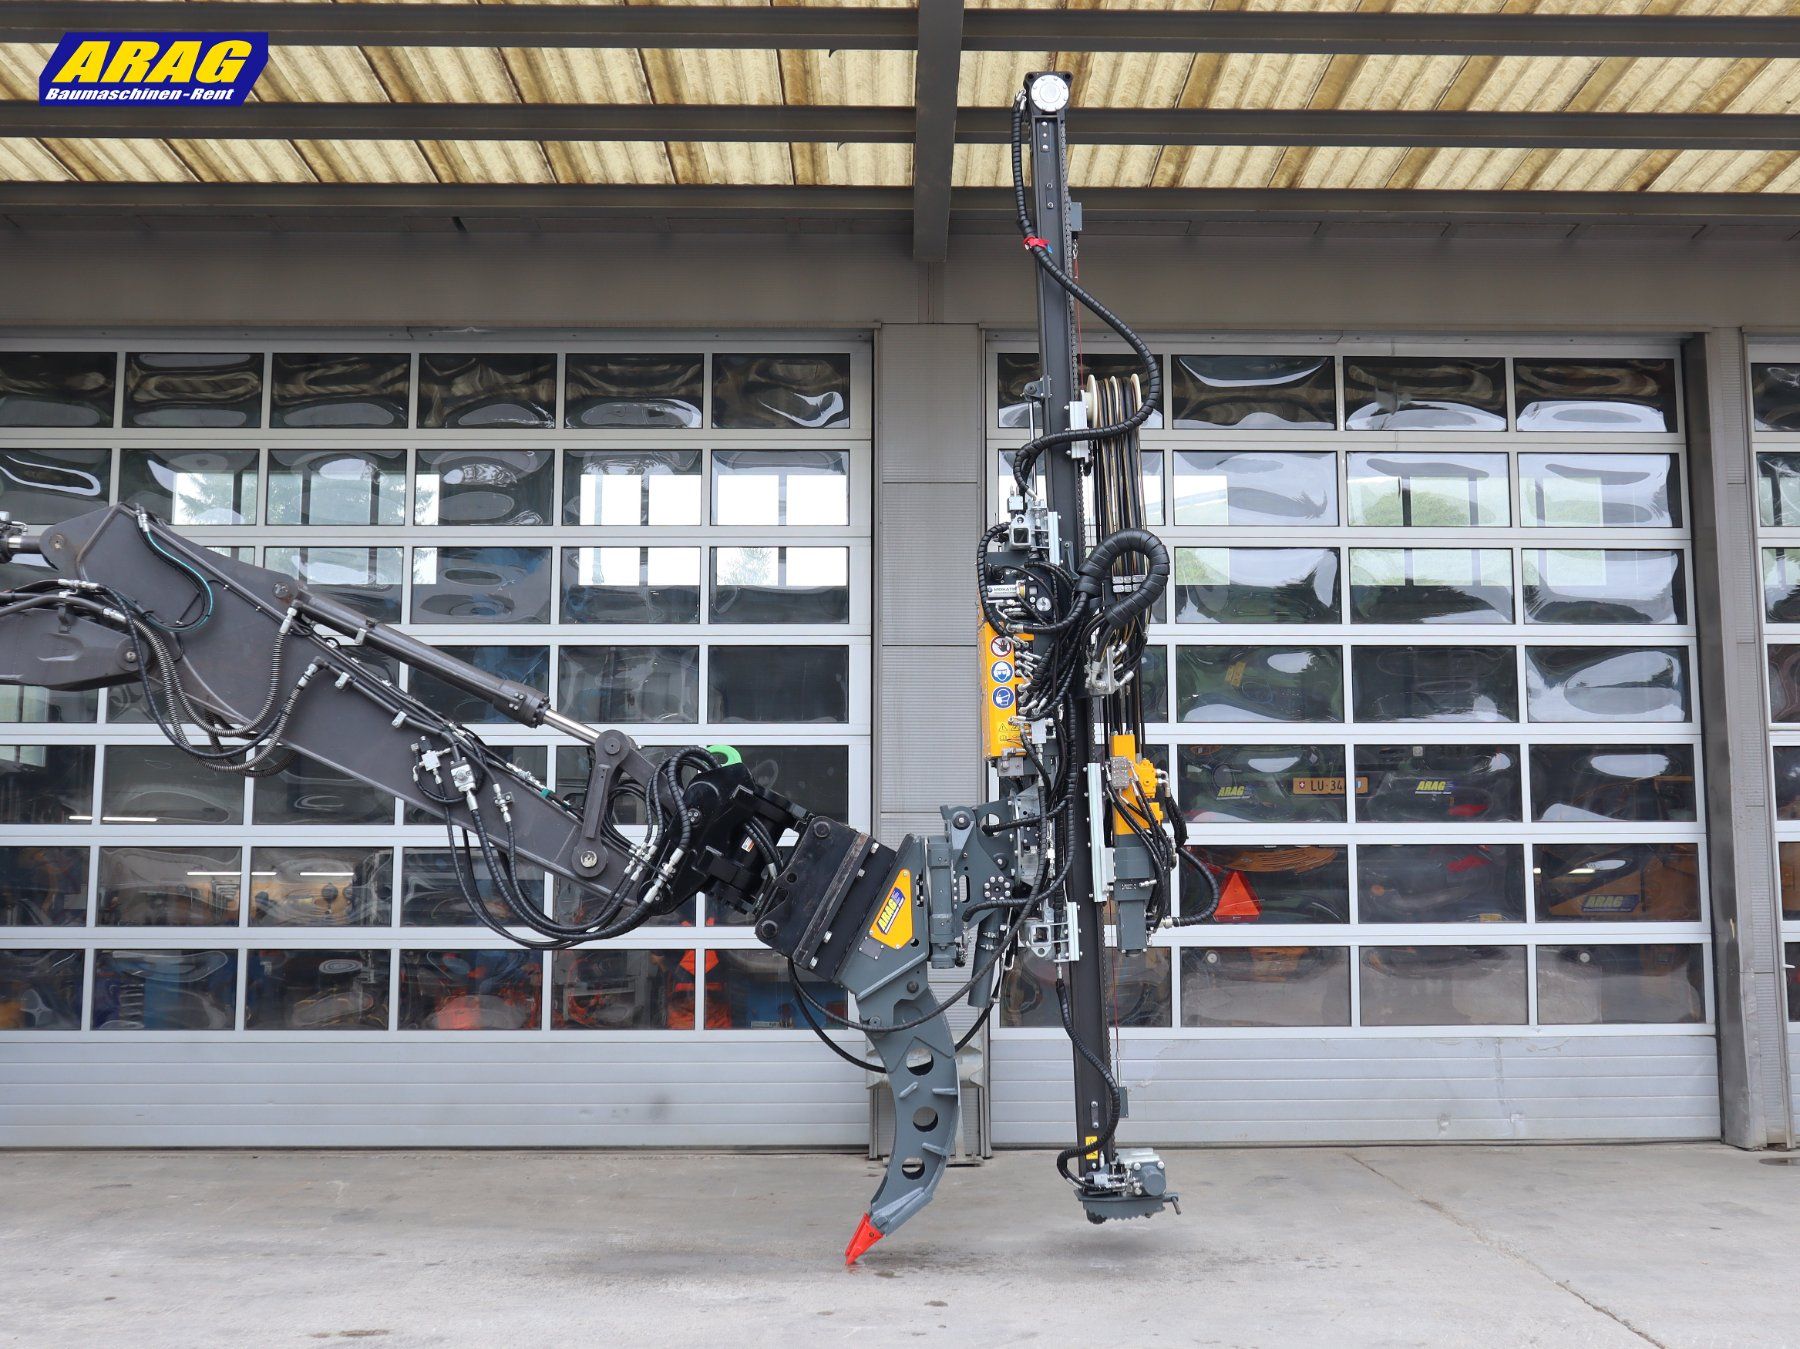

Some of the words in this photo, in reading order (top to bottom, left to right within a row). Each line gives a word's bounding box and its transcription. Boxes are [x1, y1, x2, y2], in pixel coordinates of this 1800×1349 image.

[1217, 785, 1245, 797] ARAG
[1416, 780, 1446, 791] ARAG
[1585, 895, 1624, 908] ARAG
[878, 898, 898, 932] ARAG
